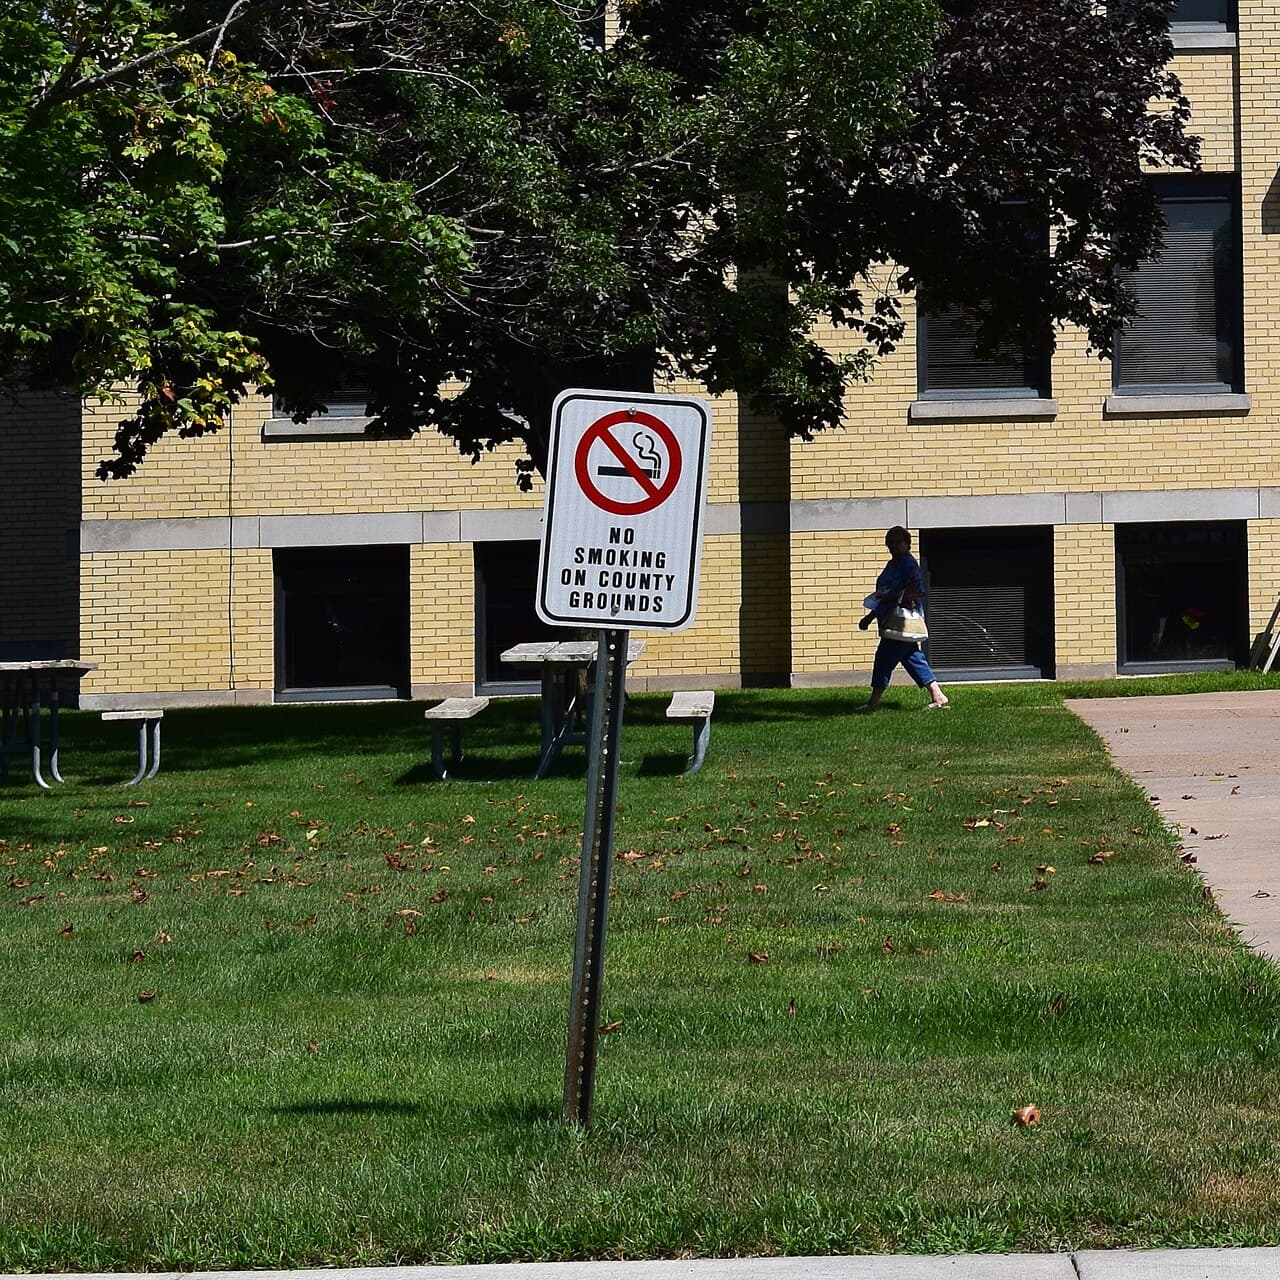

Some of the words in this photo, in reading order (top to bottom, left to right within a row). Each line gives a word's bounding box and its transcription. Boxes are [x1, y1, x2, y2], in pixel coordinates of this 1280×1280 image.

[609, 527, 634, 545] NO
[574, 547, 666, 569] SMOKING
[561, 568, 586, 586] ON
[598, 570, 675, 591] COUNTY
[569, 591, 663, 613] GROUNDS
